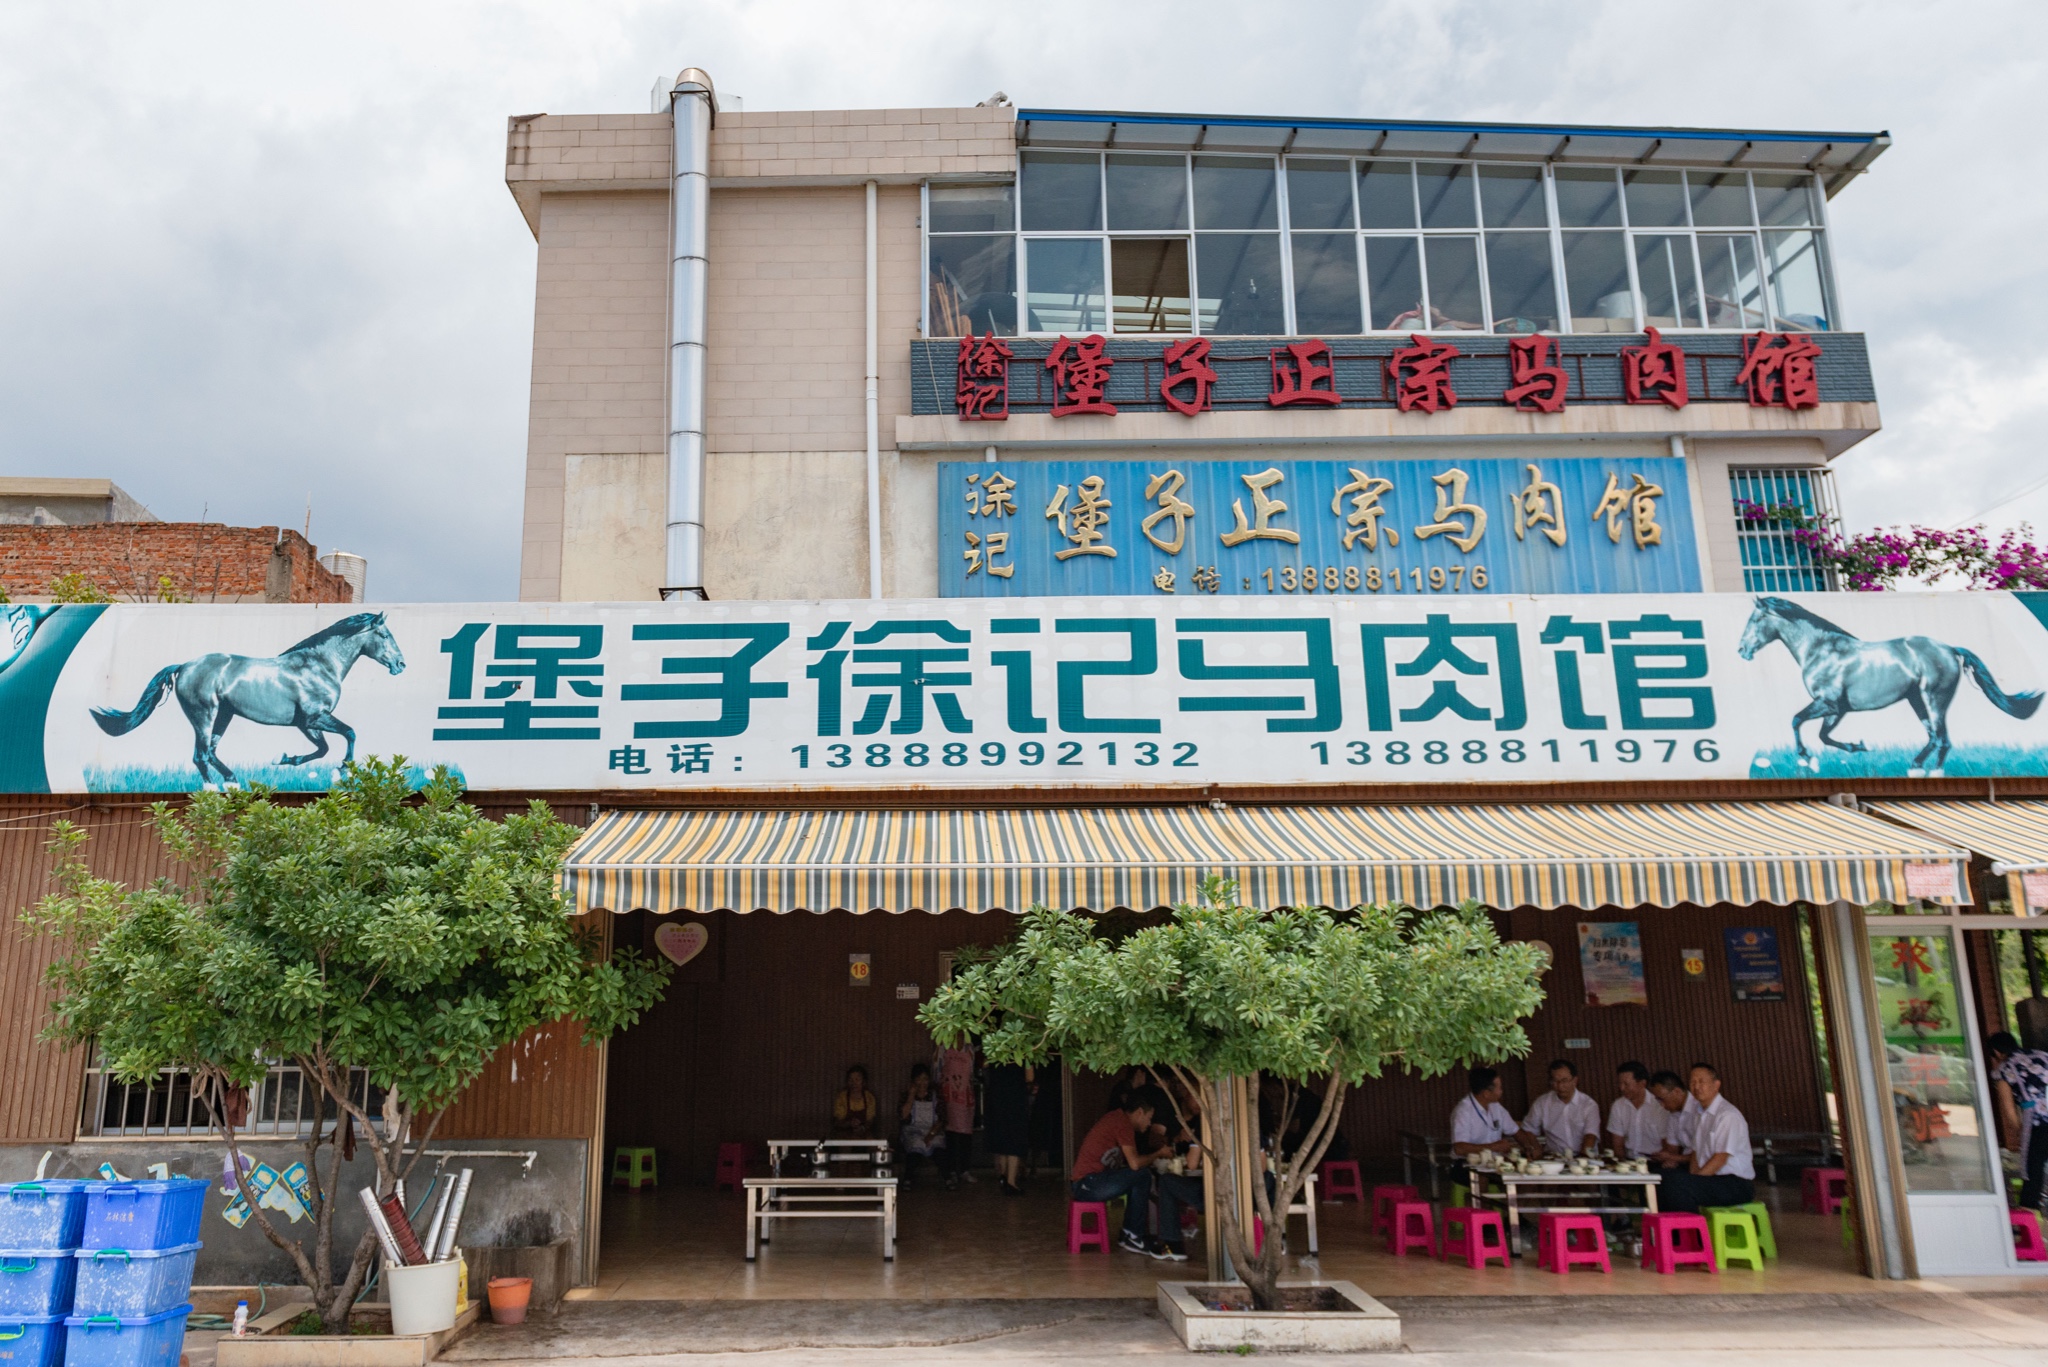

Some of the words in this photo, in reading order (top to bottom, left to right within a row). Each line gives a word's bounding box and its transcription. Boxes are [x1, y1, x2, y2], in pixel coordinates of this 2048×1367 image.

[957, 331, 1013, 421] 徐记
[1045, 326, 1822, 416] 堡子正宗马肉馆
[1045, 463, 1664, 559] 堡子正宗马肉馆
[432, 613, 1718, 741] 堡子徐记马肉馆
[790, 741, 1199, 769] 13888992132
[1310, 738, 1720, 765] 13888811976
[853, 963, 867, 977] 18
[1687, 960, 1702, 972] 15
[1891, 940, 1953, 1142] 欢迎光临
